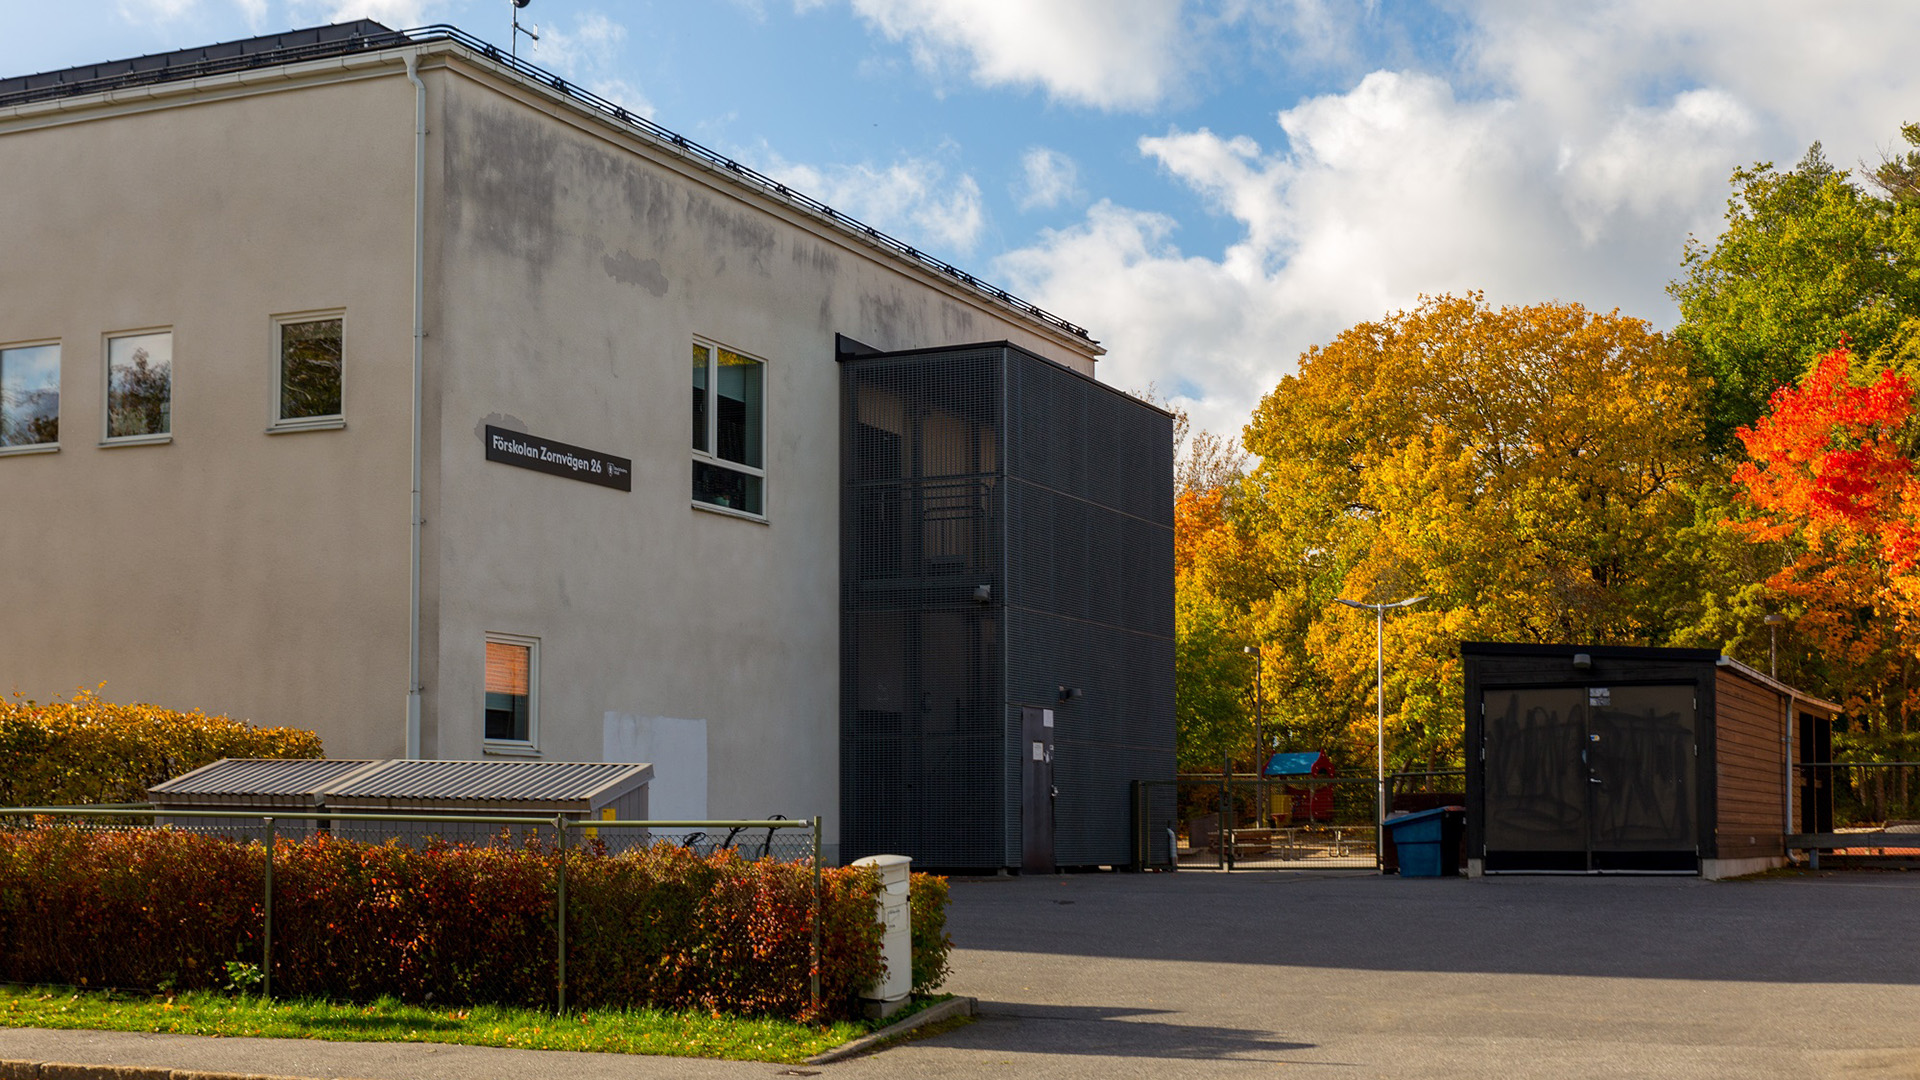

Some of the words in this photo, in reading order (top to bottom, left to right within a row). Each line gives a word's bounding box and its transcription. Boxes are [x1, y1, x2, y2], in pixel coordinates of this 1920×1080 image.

[493, 435, 539, 459] Förskolan
[540, 446, 589, 471] Zornvägen
[591, 459, 602, 473] 26
